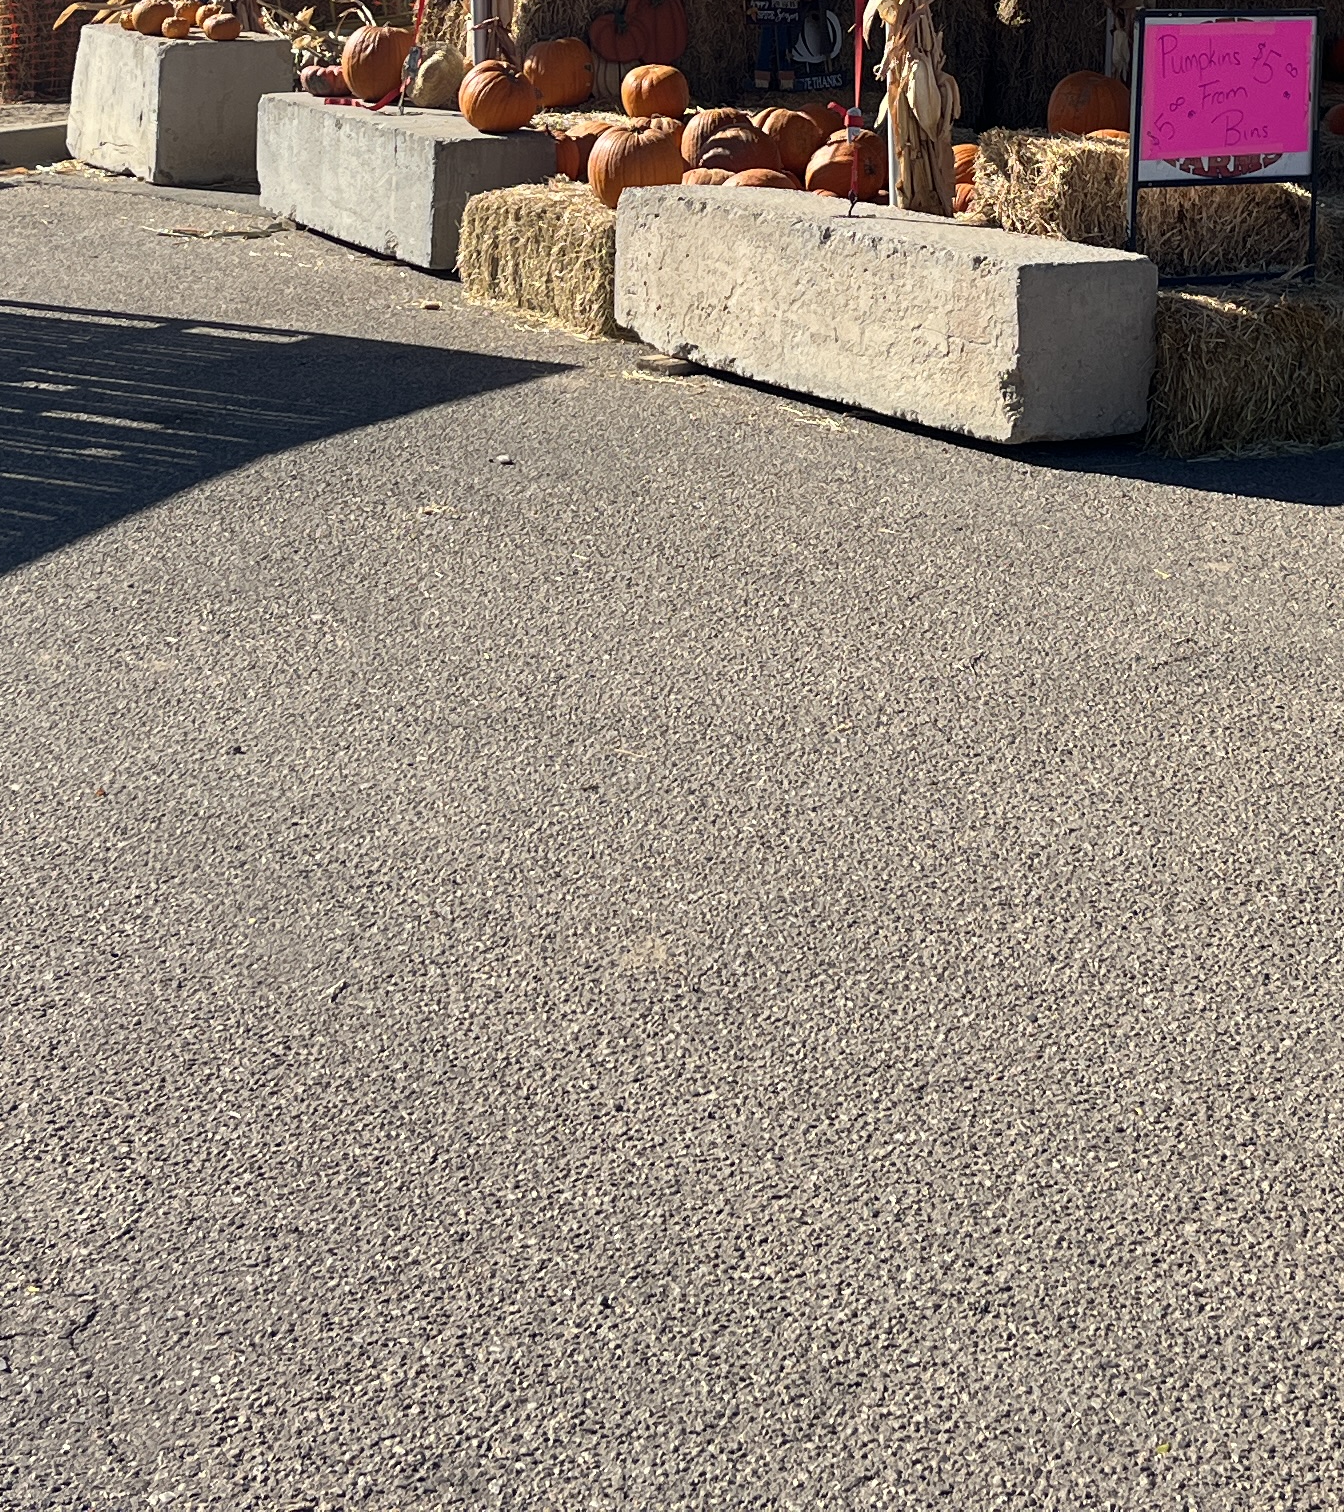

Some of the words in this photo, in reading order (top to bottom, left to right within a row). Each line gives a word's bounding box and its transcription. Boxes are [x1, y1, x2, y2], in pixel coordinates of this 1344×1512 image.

[1158, 34, 1240, 79] Pumpkins
[1198, 80, 1248, 110] From
[1211, 109, 1268, 147] Bins
